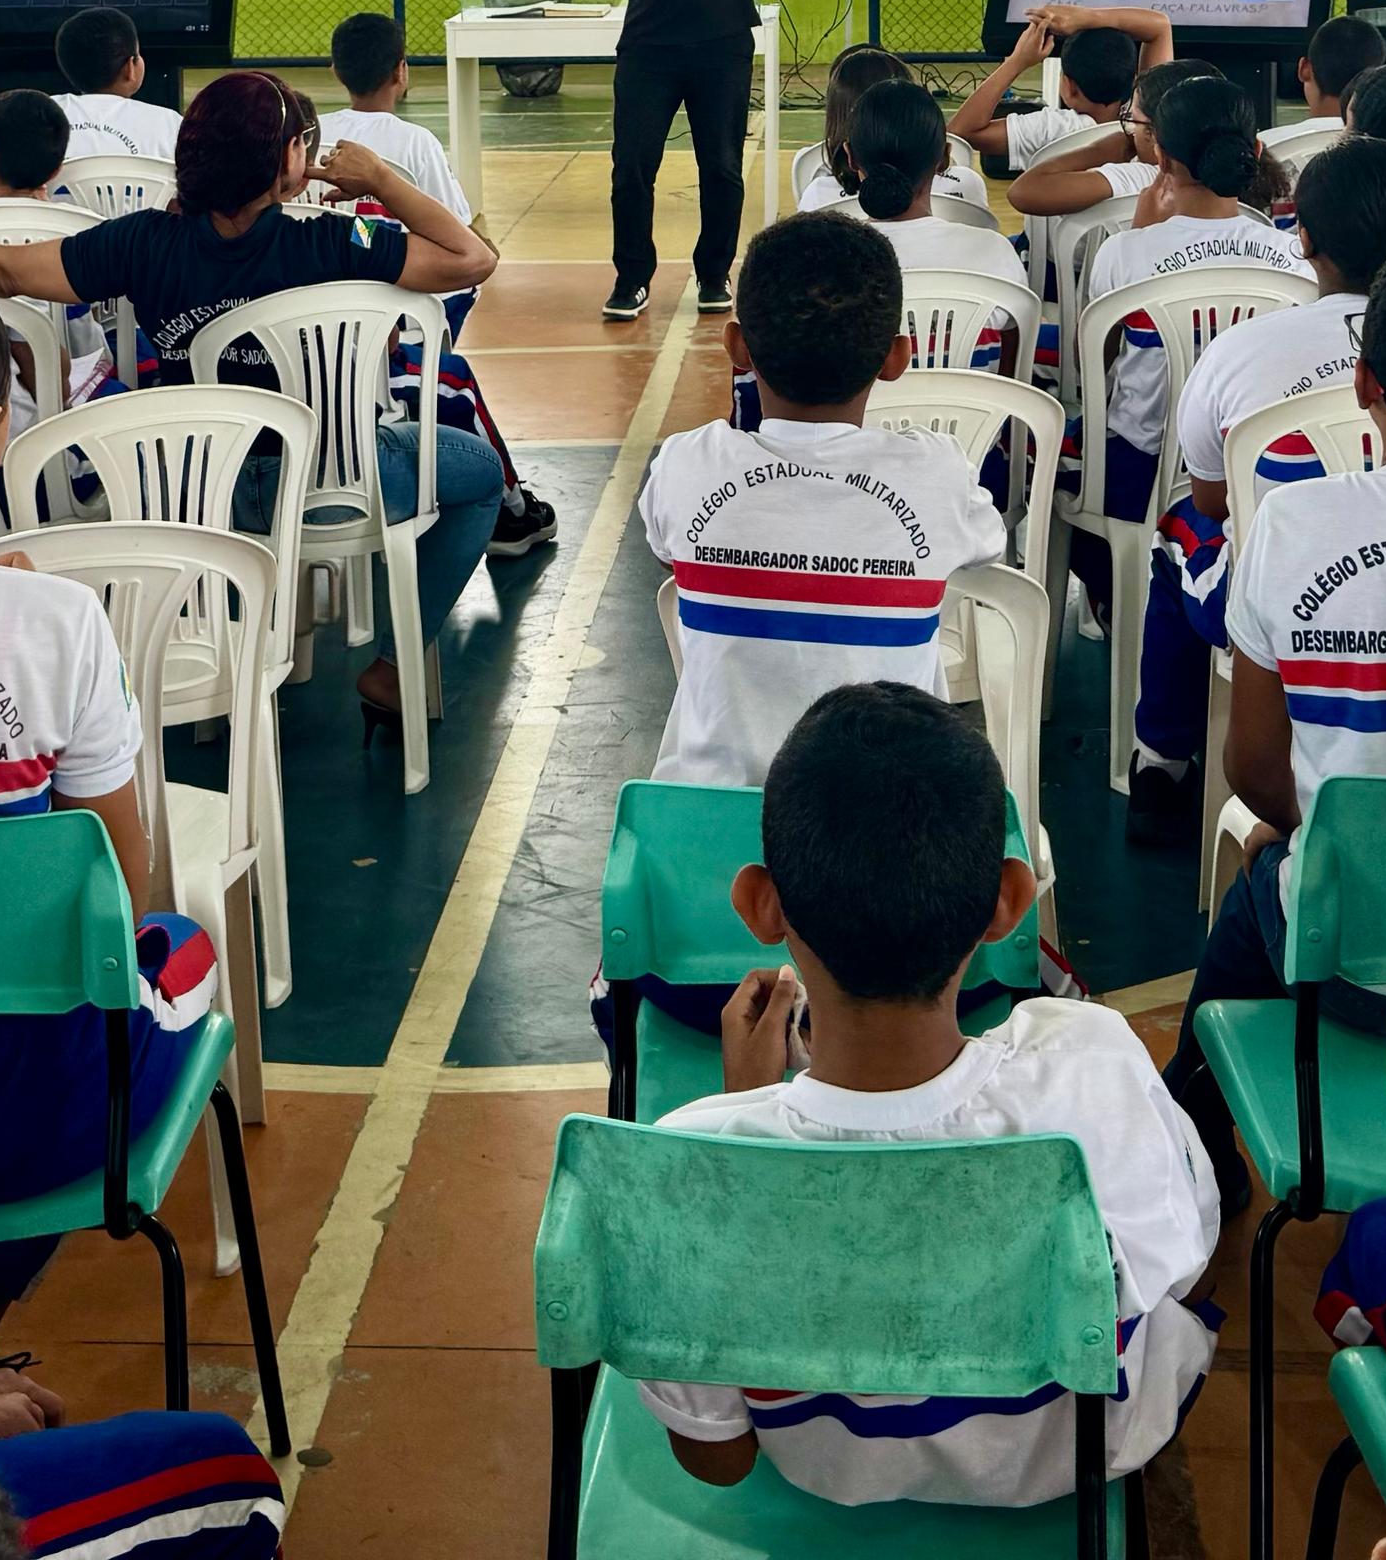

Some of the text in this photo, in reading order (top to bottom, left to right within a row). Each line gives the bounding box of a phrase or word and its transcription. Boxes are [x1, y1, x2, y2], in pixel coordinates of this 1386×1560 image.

[1185, 240, 1242, 262] ESTADUAL
[1244, 241, 1292, 269] MILITARIZ
[686, 481, 737, 544] COLÉGIO
[845, 472, 931, 560] MILITARIZADO
[695, 545, 916, 577] DESEMBARGADOR SADOC PEREIRA
[1292, 554, 1358, 622] COLÉGIO
